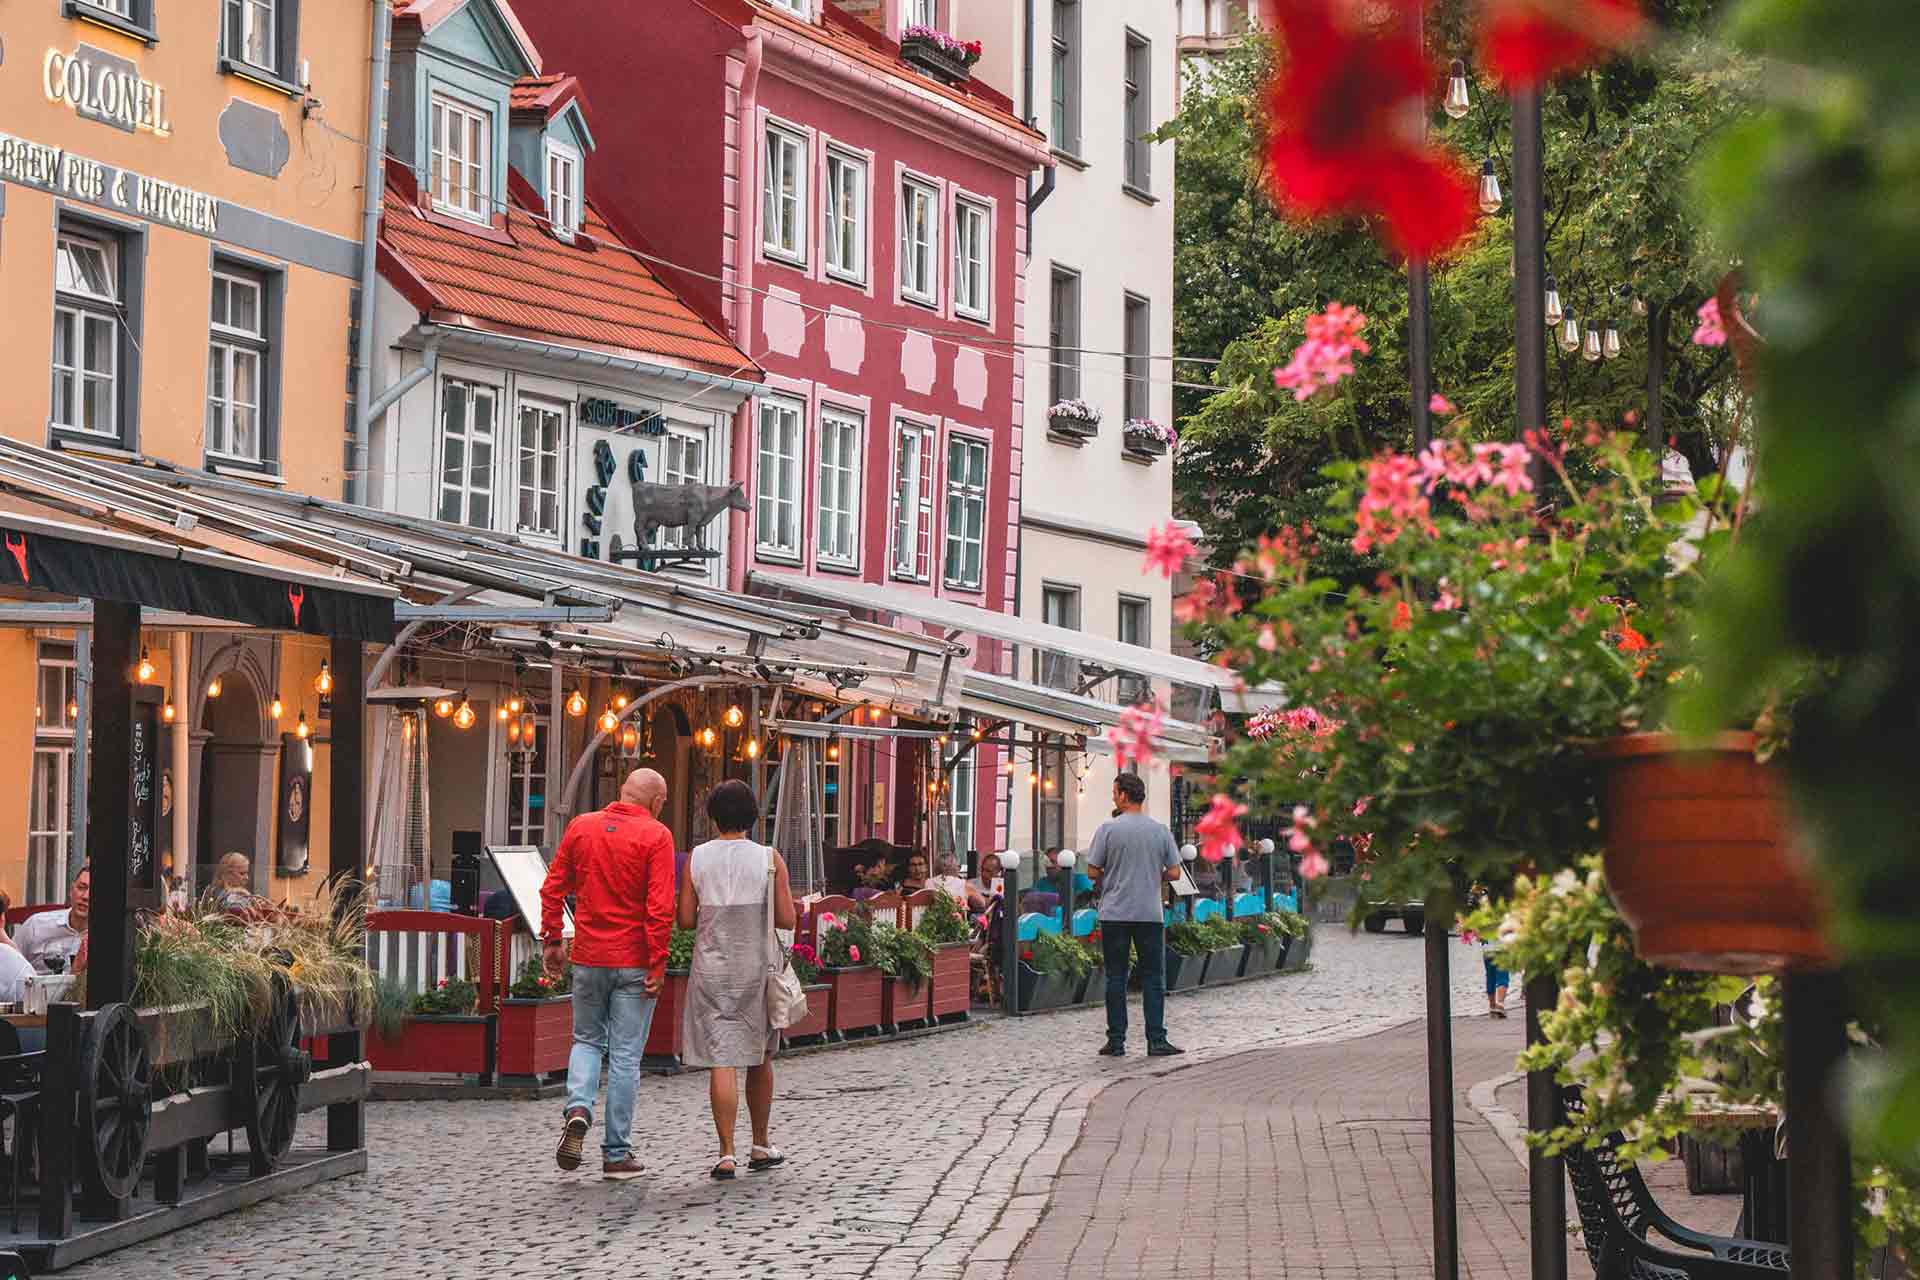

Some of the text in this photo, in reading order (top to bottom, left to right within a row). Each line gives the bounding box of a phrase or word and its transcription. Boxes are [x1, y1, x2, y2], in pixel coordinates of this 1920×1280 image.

[43, 48, 174, 136] COLONEL
[1, 138, 219, 233] BREW PUB & KITCHEN
